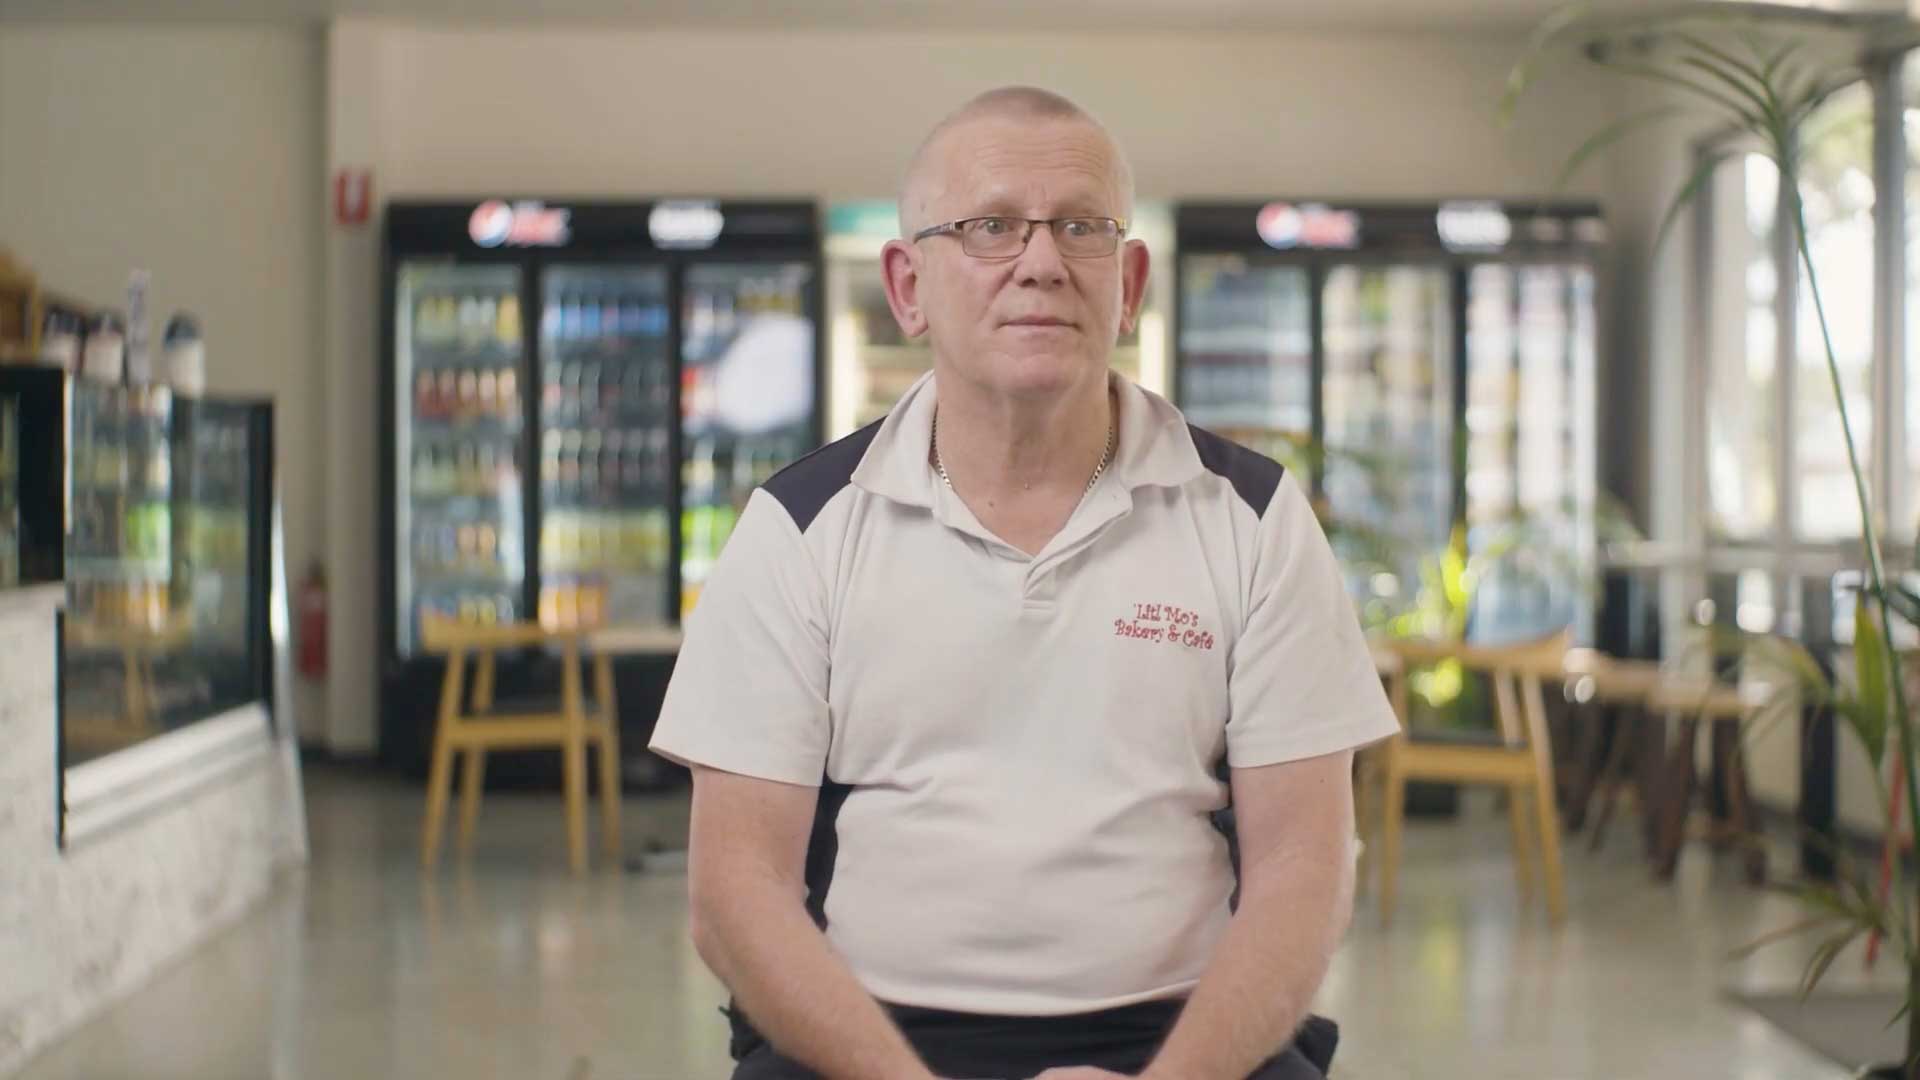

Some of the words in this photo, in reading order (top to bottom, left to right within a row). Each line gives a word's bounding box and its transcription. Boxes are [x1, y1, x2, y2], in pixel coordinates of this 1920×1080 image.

[1164, 606, 1199, 627] Mo's
[1114, 619, 1164, 643] Bakery
[1167, 624, 1181, 642] &
